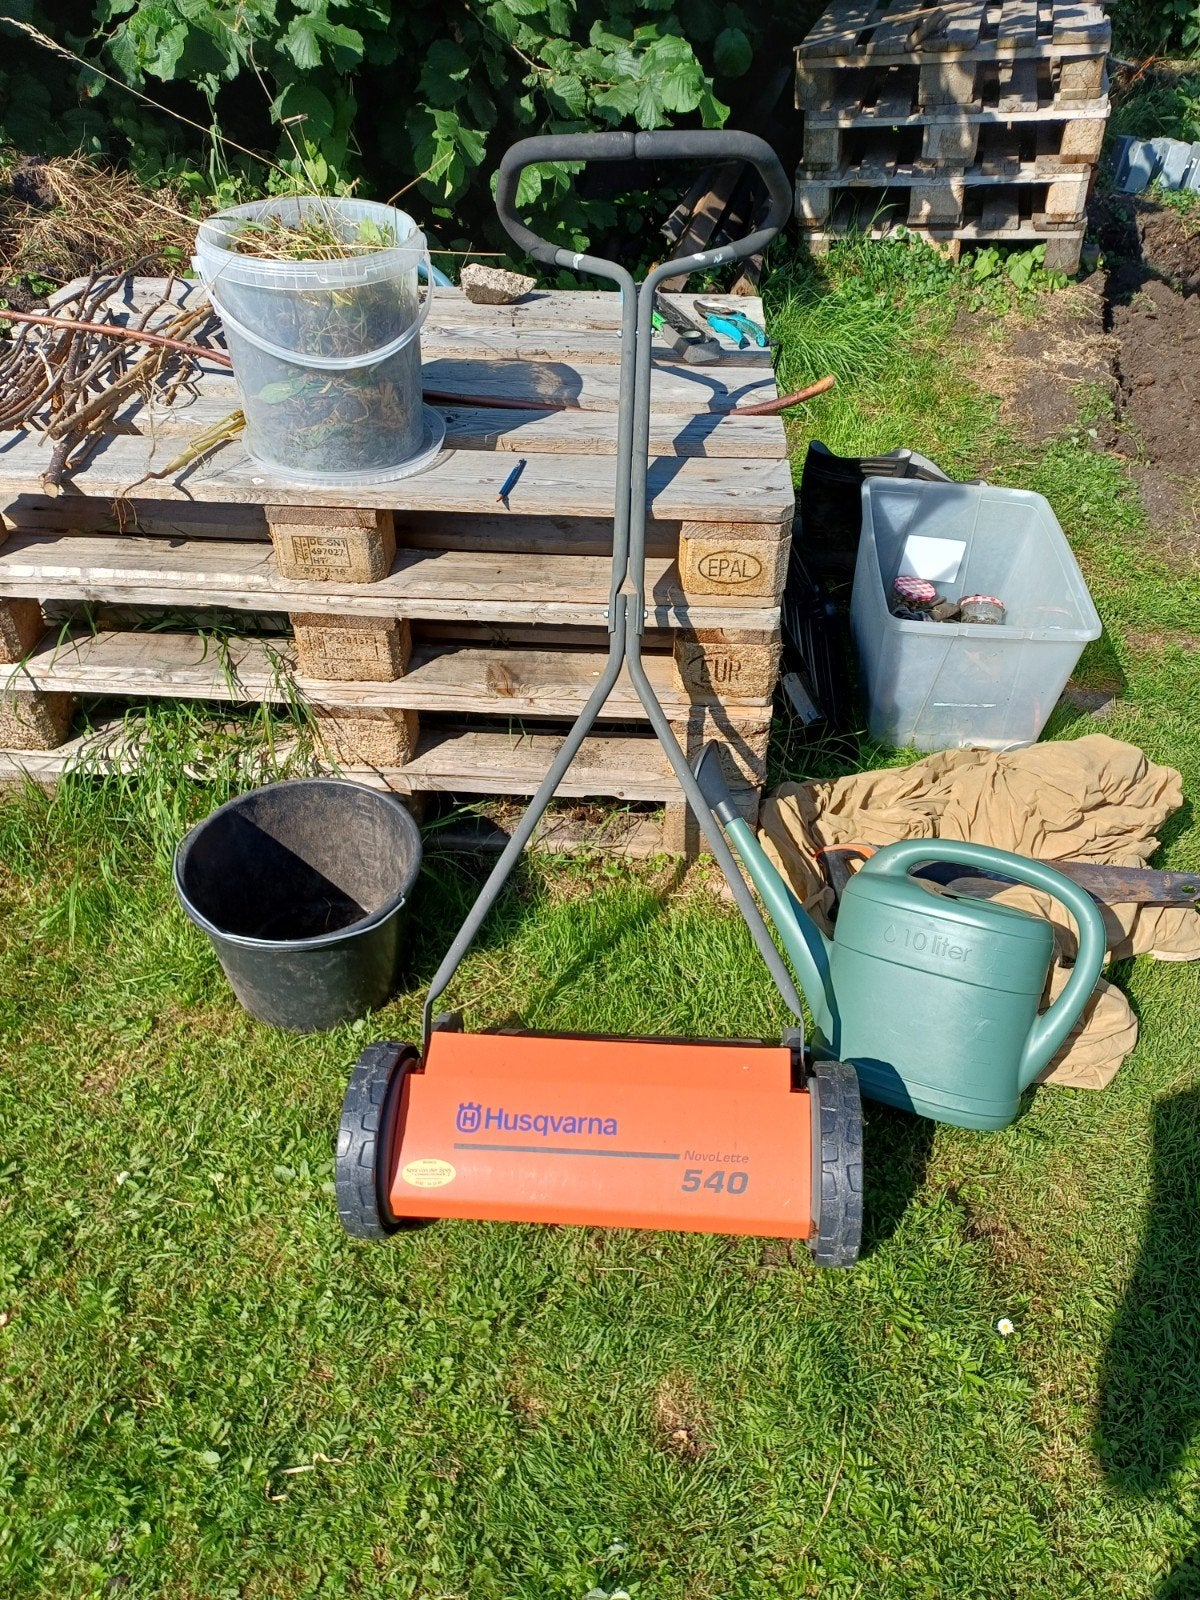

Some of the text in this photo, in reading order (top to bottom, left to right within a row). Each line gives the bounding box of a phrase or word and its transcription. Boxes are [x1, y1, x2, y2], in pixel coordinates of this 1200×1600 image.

[708, 558, 752, 578] EPAL
[905, 927, 973, 962] 10 liter
[484, 1107, 618, 1136] Husqvarna
[684, 1150, 749, 1163] NovoLette
[681, 1168, 749, 1195] 540
